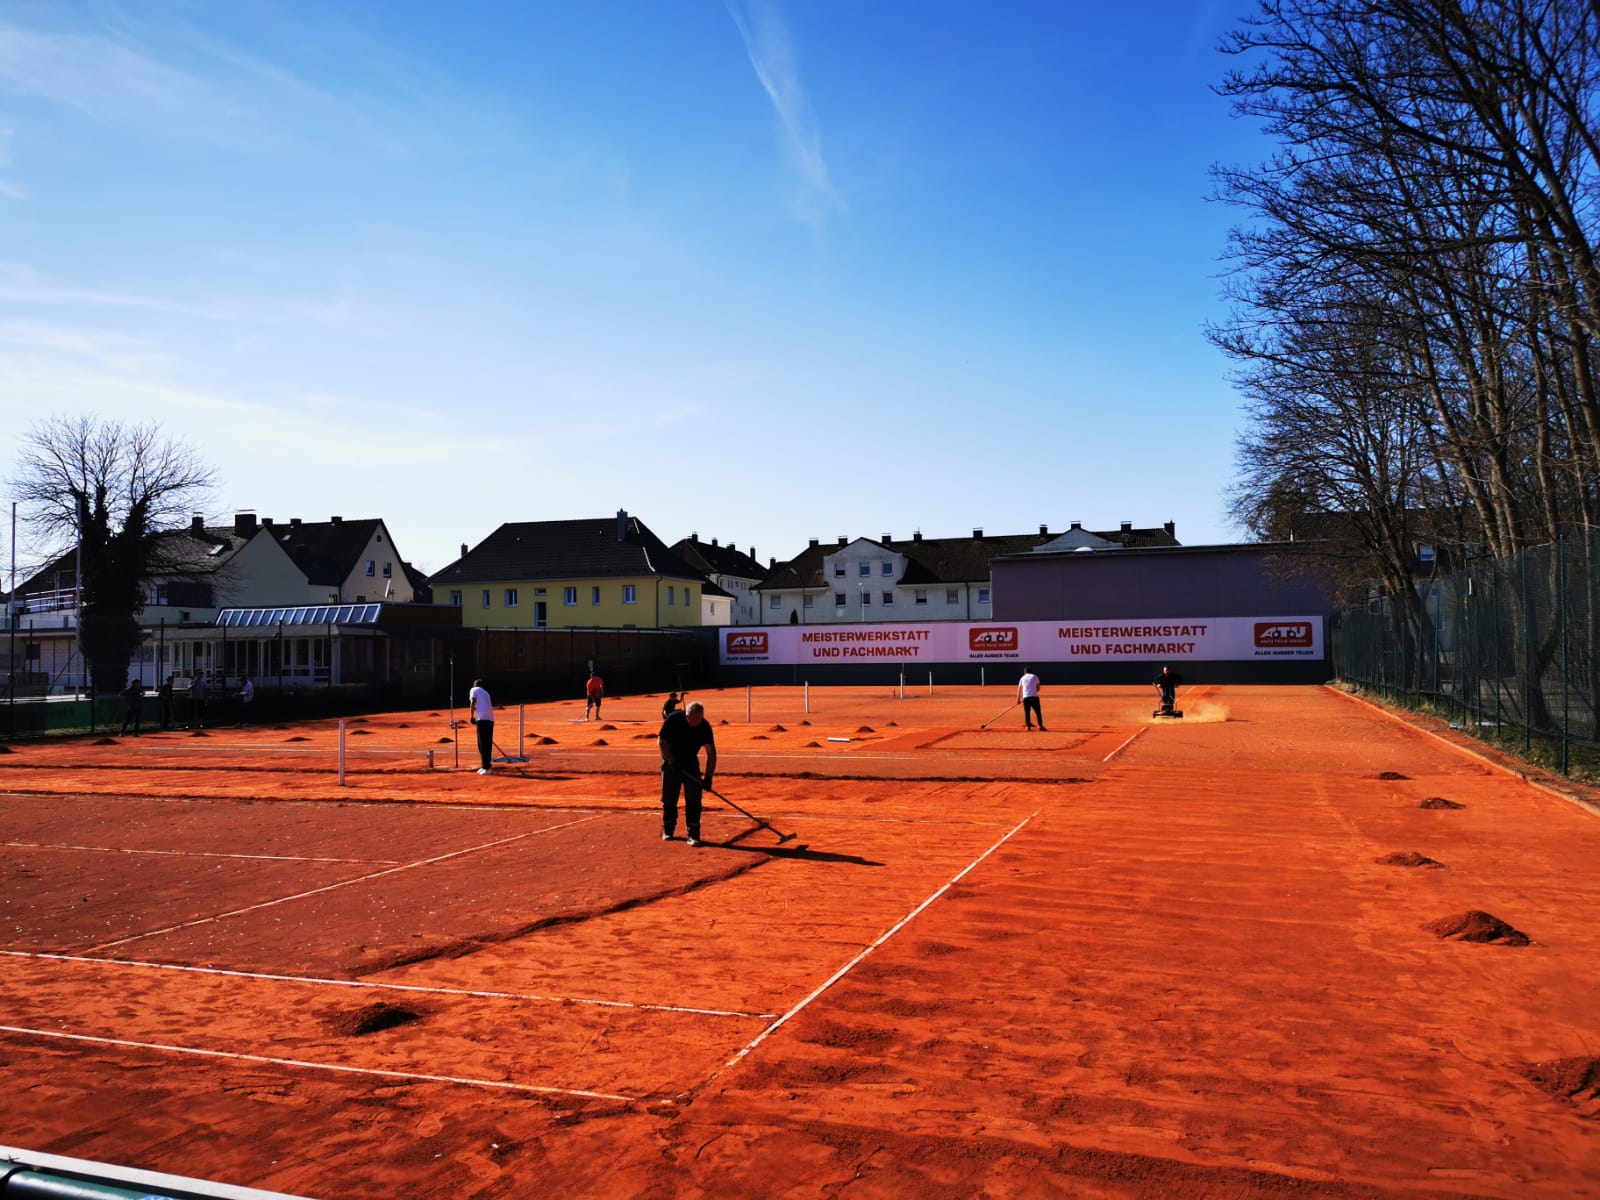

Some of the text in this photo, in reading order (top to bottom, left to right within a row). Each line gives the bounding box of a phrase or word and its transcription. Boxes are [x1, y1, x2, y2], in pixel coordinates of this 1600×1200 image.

[802, 630, 930, 642] MEISTERWERKSTATT
[1058, 625, 1207, 638] MEISTERWERKSTATT
[813, 646, 920, 657] UND FACHMARKT
[1070, 642, 1195, 655] UND FACHMARKT
